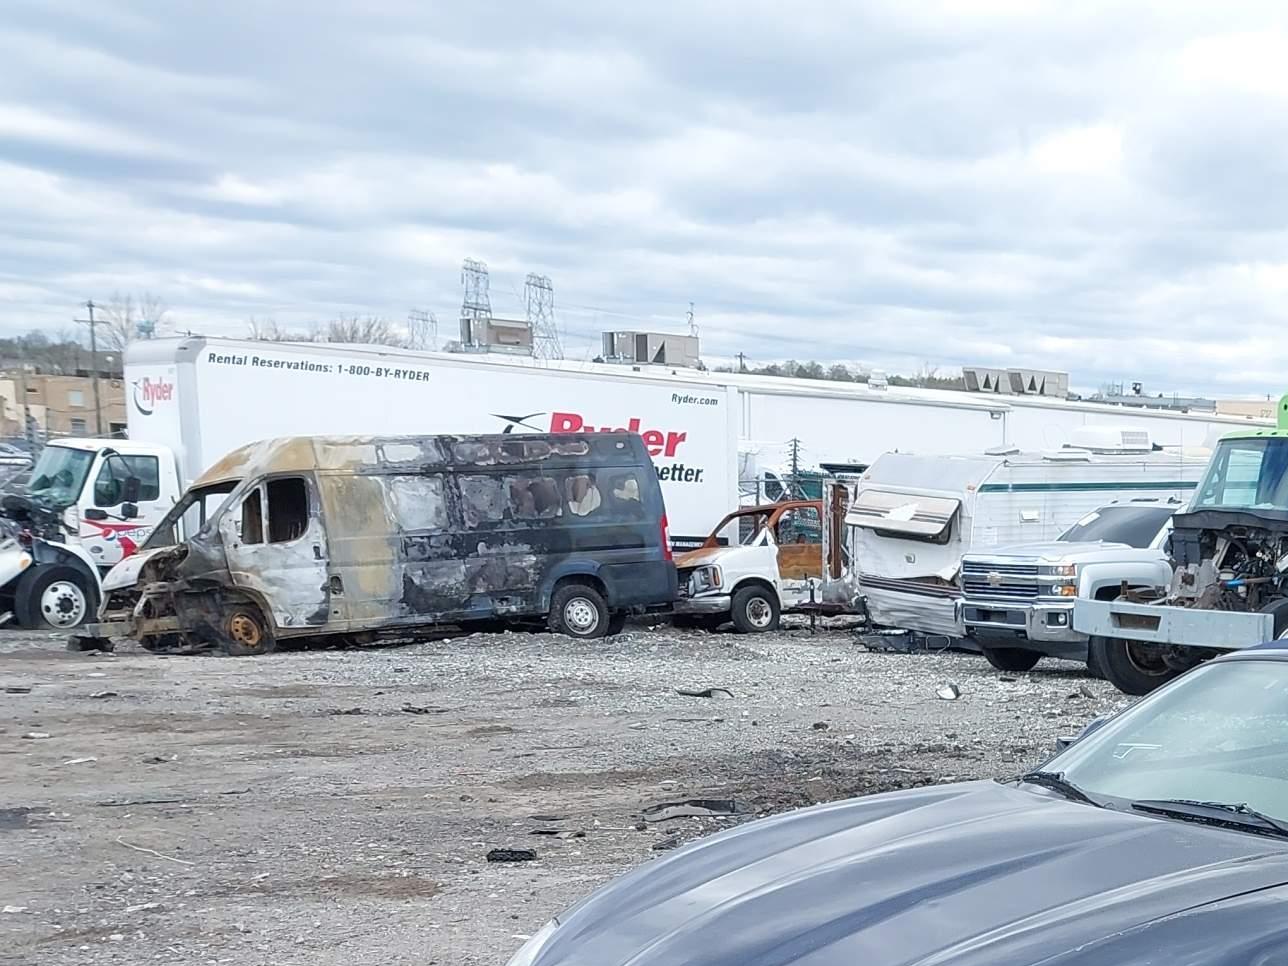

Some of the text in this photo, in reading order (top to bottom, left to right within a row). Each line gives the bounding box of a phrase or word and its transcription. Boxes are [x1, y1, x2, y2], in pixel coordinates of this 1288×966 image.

[208, 352, 430, 382] Rental Reservations: 1-800-BY-RYDER
[143, 376, 173, 407] Ryder
[672, 394, 718, 405] Ryder.com
